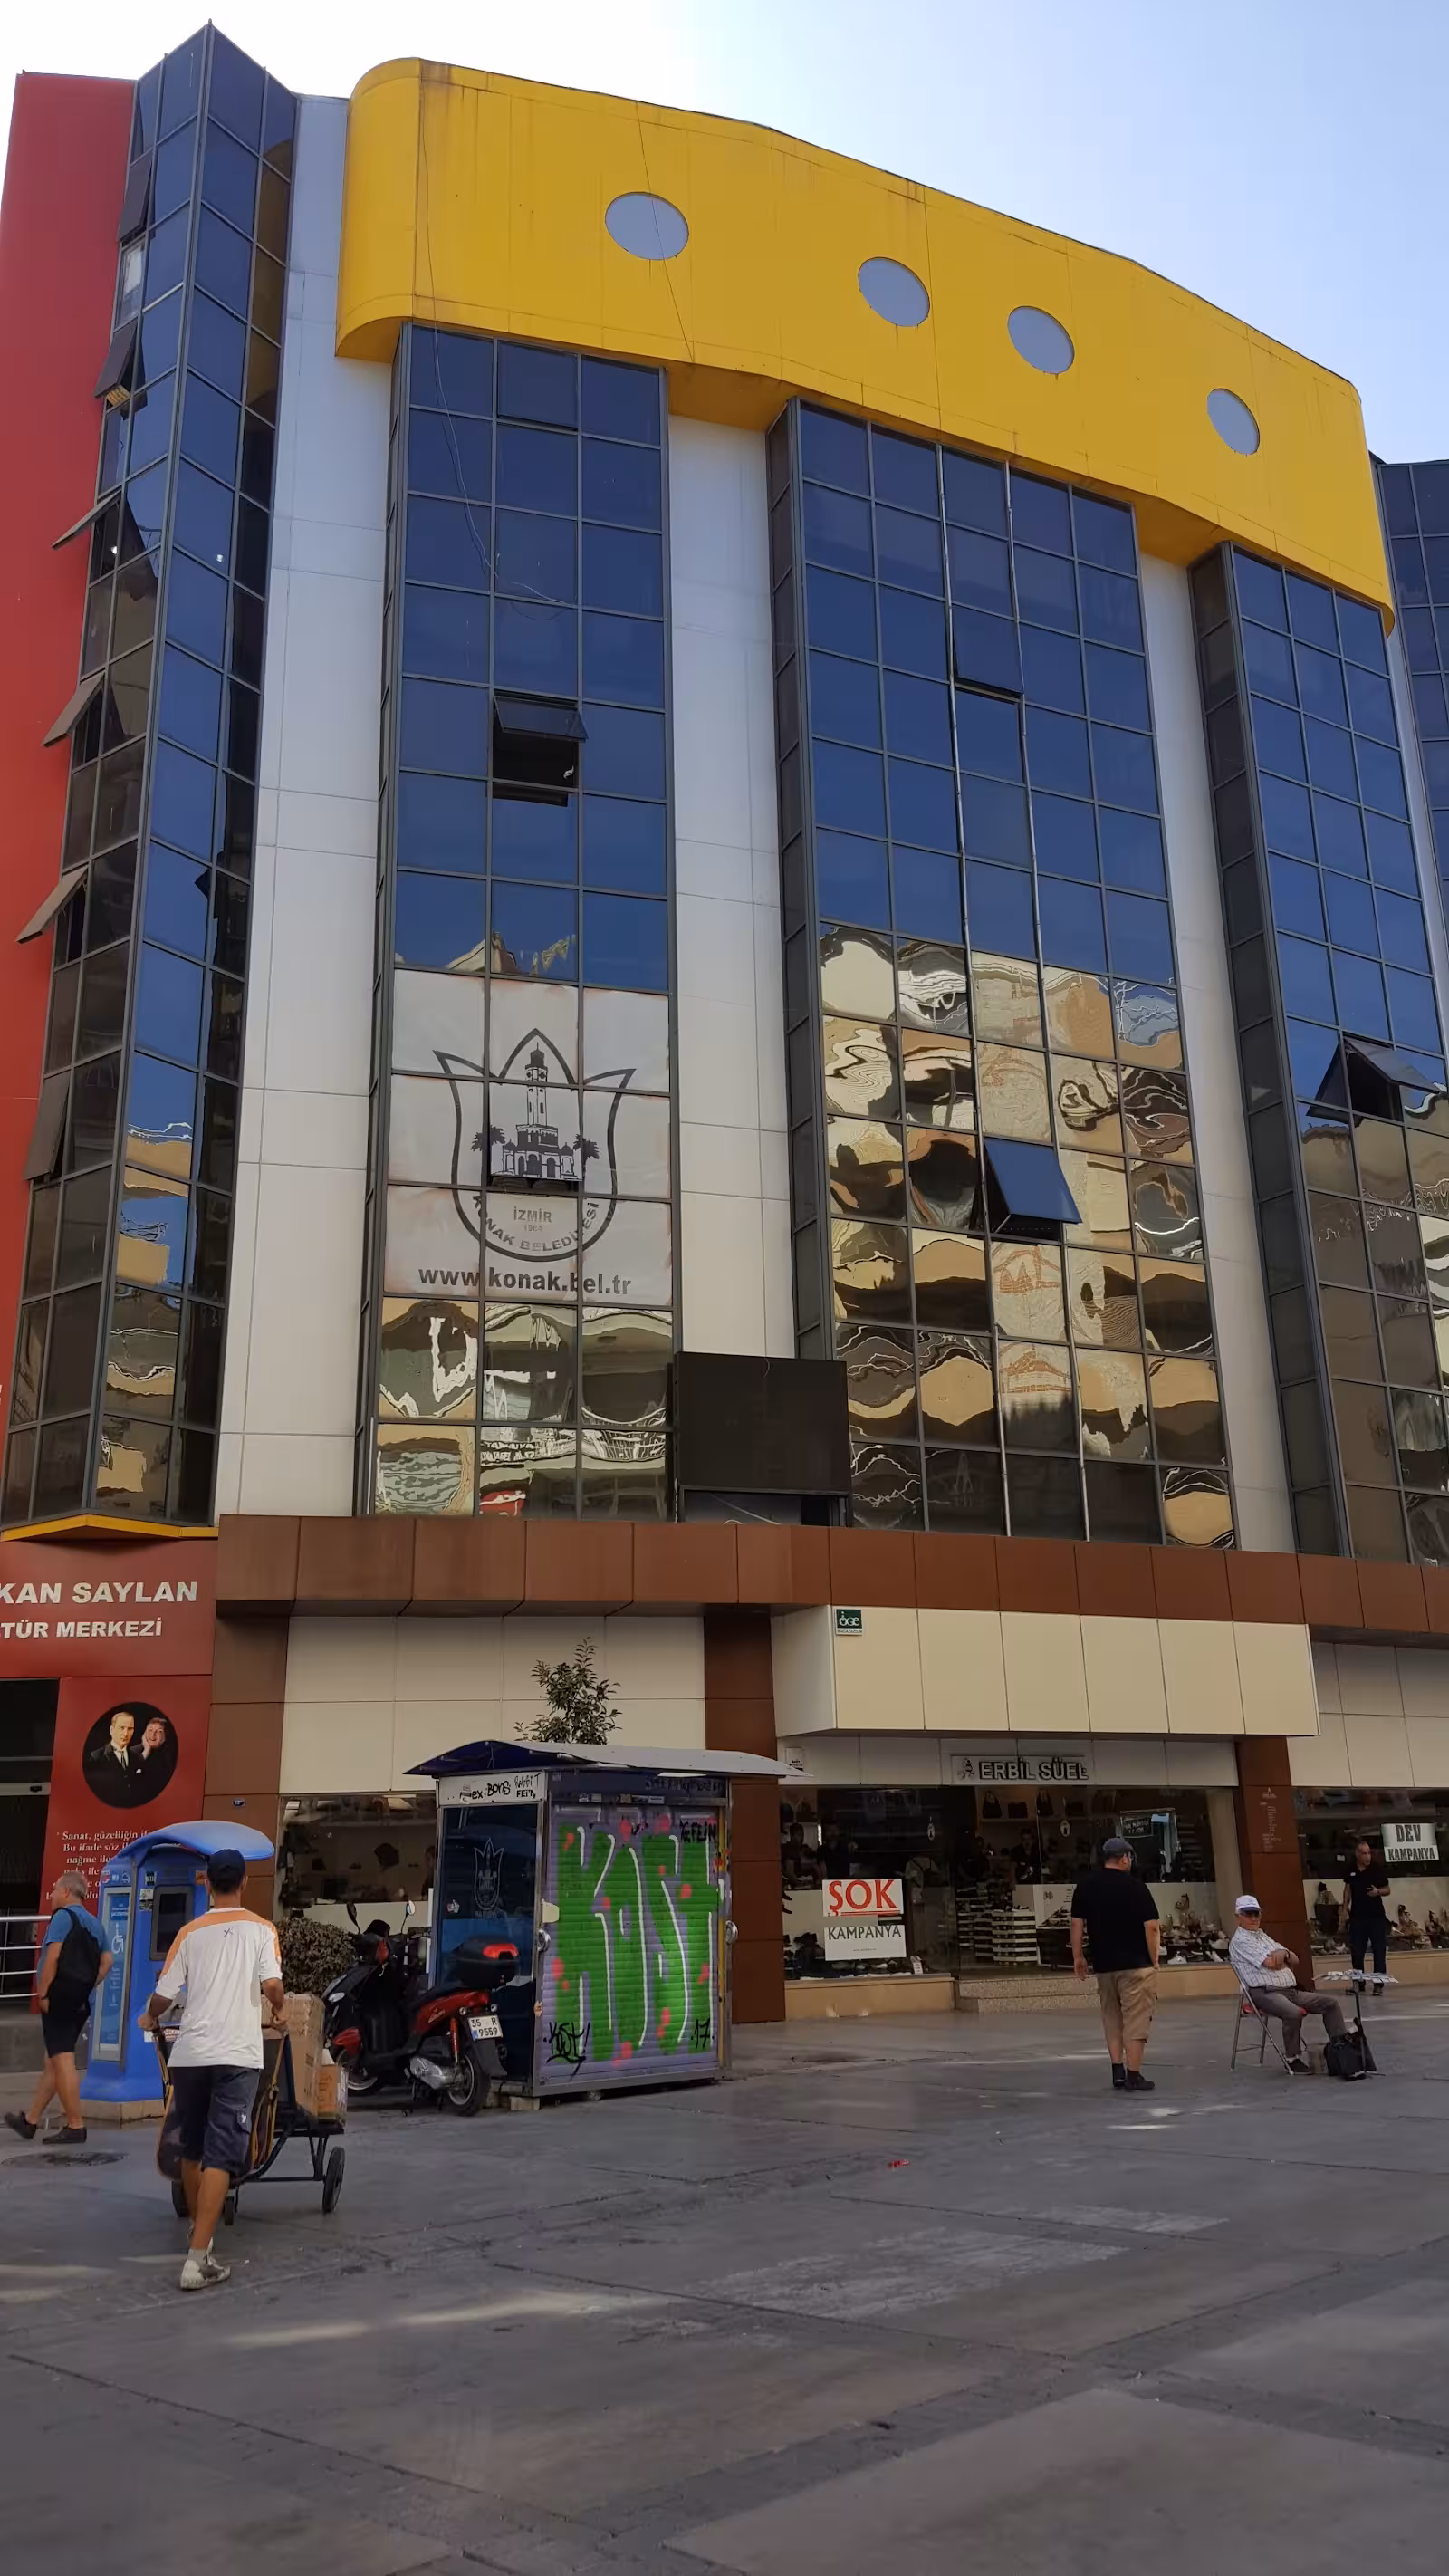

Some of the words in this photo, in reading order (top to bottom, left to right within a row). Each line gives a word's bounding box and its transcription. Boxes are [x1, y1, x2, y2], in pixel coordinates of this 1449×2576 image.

[513, 1206, 552, 1223] İZMİR
[519, 1197, 600, 1252] BELEDİESİ
[418, 1266, 632, 1294] wwwkonak.bel.tr
[72, 1581, 197, 1603] SAYLAN
[56, 1617, 162, 1638] MERKEZİ
[979, 1757, 1036, 1780] ERBİL
[1039, 1757, 1089, 1780] SÜEL
[1396, 1824, 1421, 1842] DEV
[62, 1843, 76, 1852] Bu
[79, 1842, 101, 1852] ifade
[1387, 1848, 1435, 1861] KAMPANYA
[829, 1879, 897, 1916] ŞOK
[828, 1925, 901, 1940] KAMPANYA
[470, 2019, 482, 2028] 35
[478, 2027, 499, 2037] 9559
